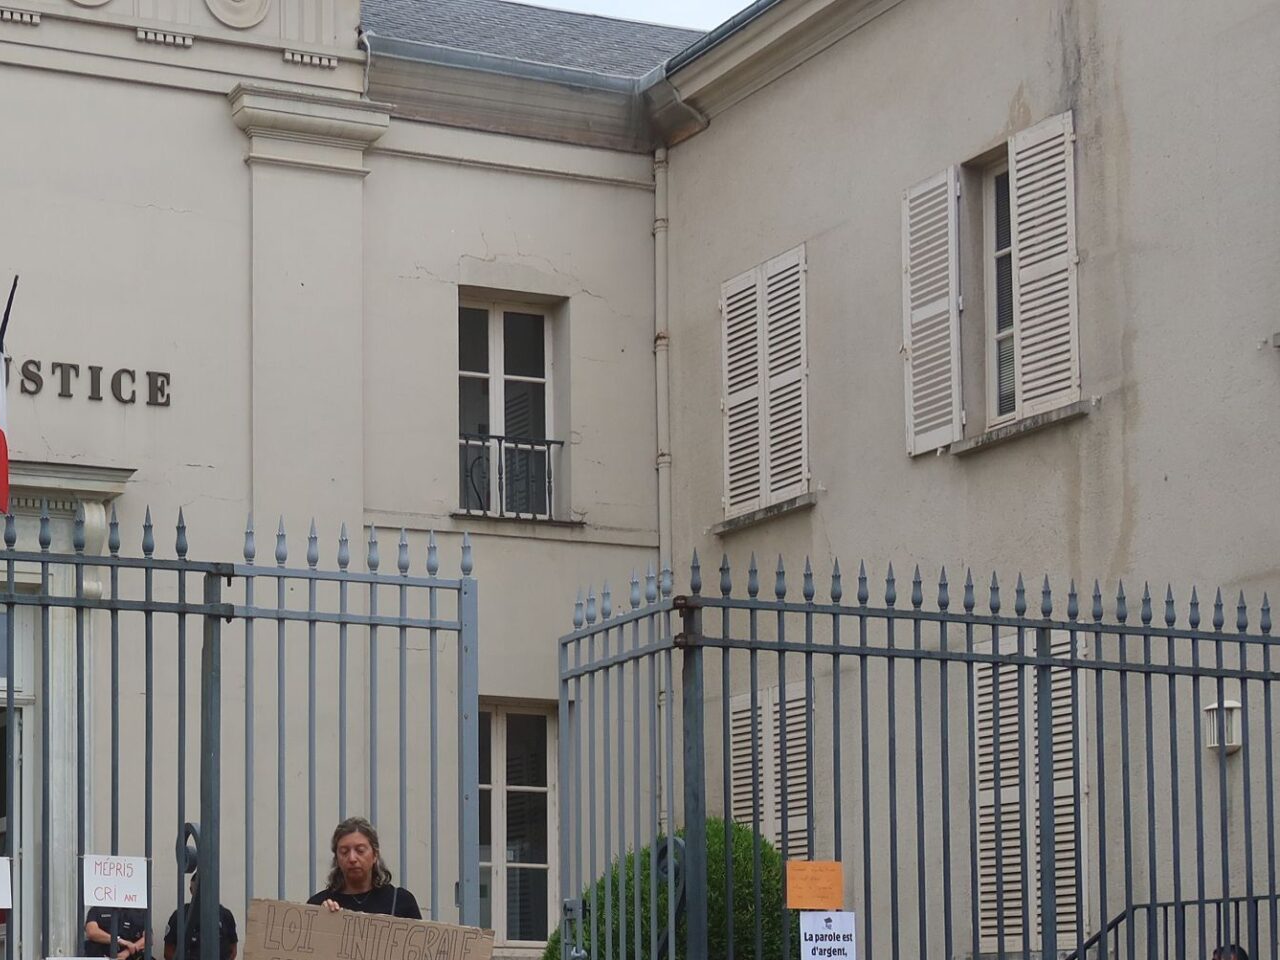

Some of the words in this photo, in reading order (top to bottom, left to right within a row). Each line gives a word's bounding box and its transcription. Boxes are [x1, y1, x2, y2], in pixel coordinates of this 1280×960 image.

[124, 894, 138, 902] ANT
[264, 905, 318, 954] LOI
[804, 932, 814, 942] La
[815, 932, 840, 943] parole
[842, 933, 853, 942] est
